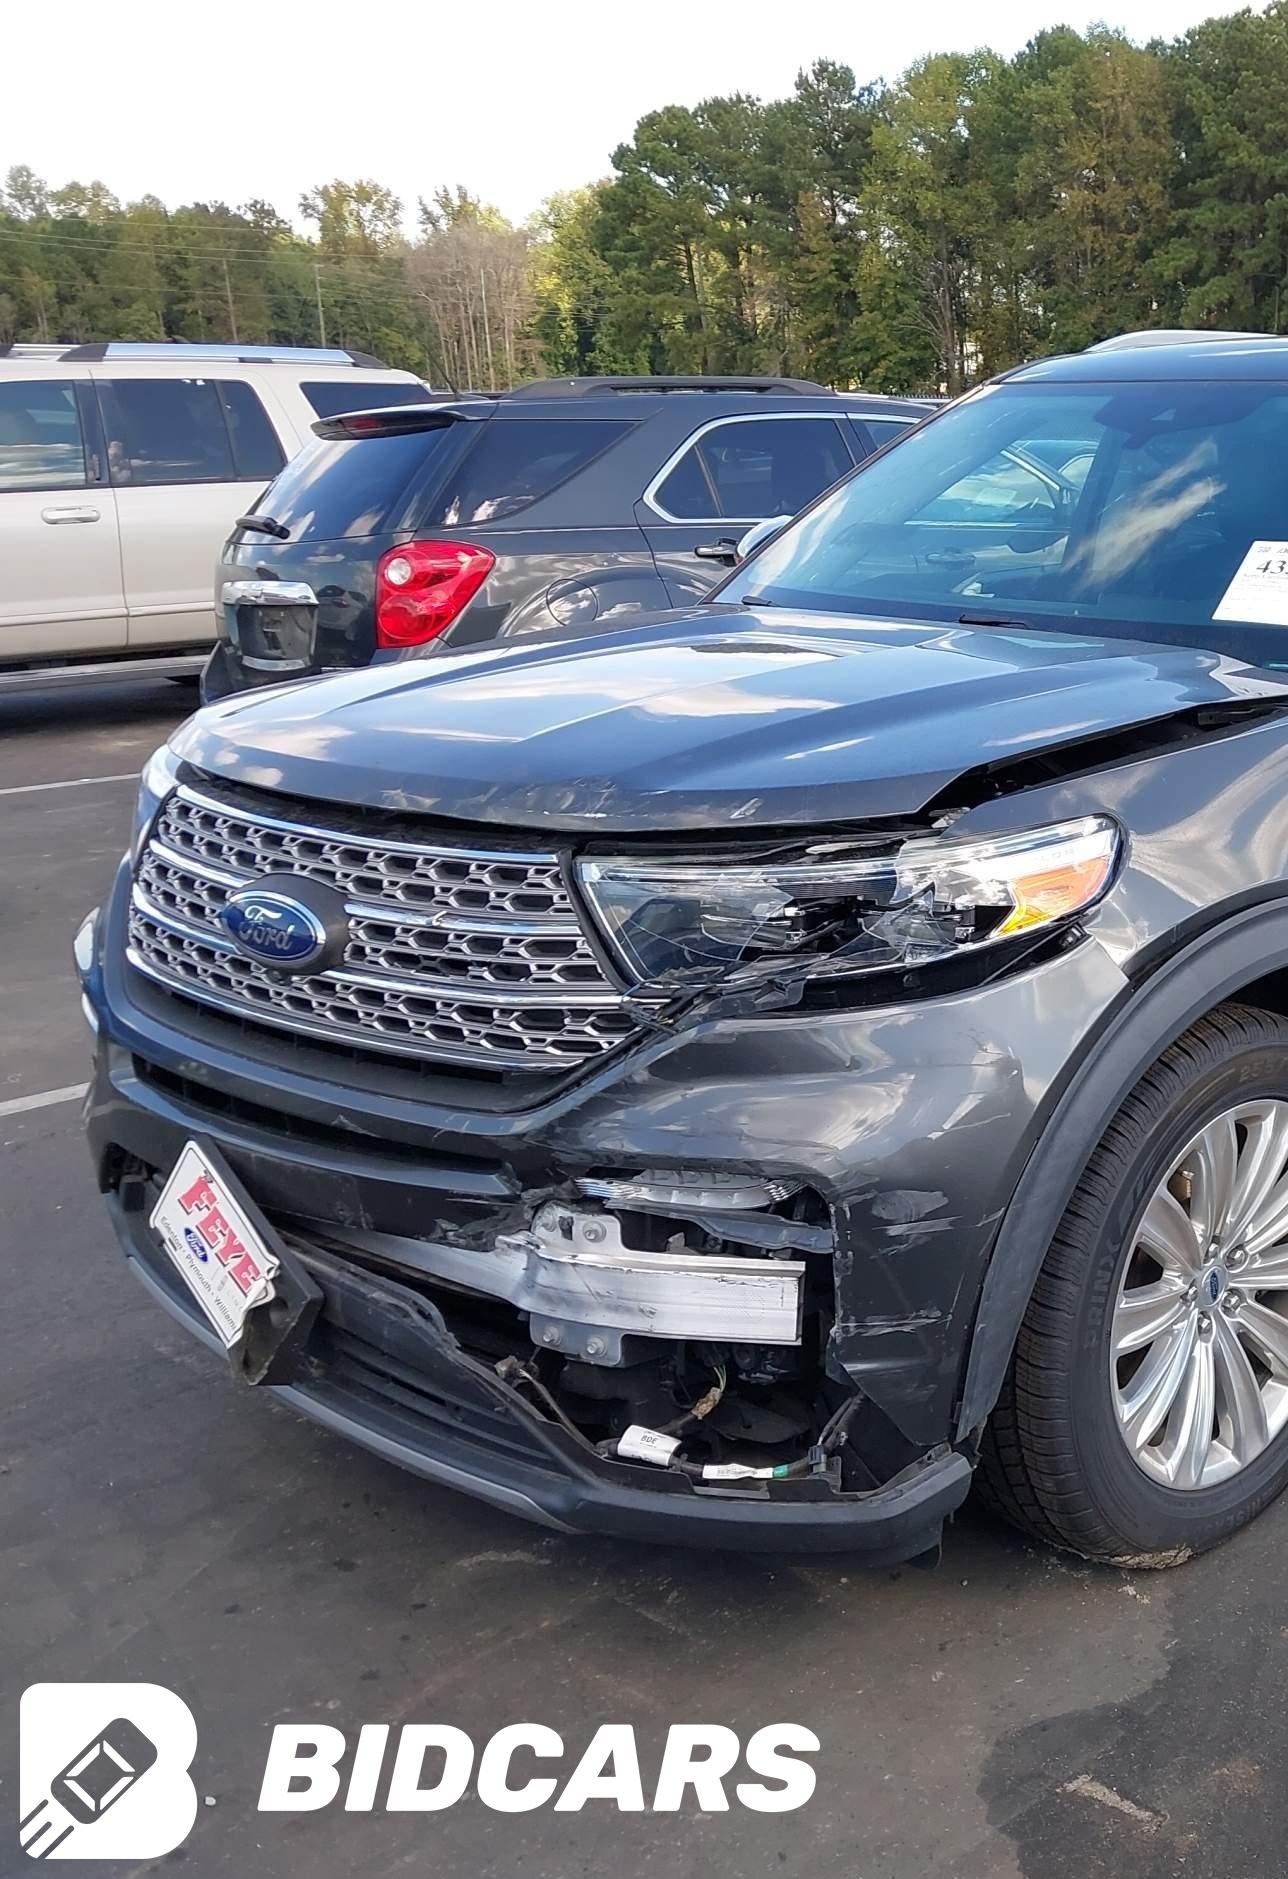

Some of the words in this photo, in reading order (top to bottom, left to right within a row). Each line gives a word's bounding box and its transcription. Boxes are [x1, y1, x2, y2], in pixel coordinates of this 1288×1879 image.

[239, 904, 295, 951] Ford
[177, 1175, 262, 1298] FEYE
[185, 1254, 211, 1297] Plymouth
